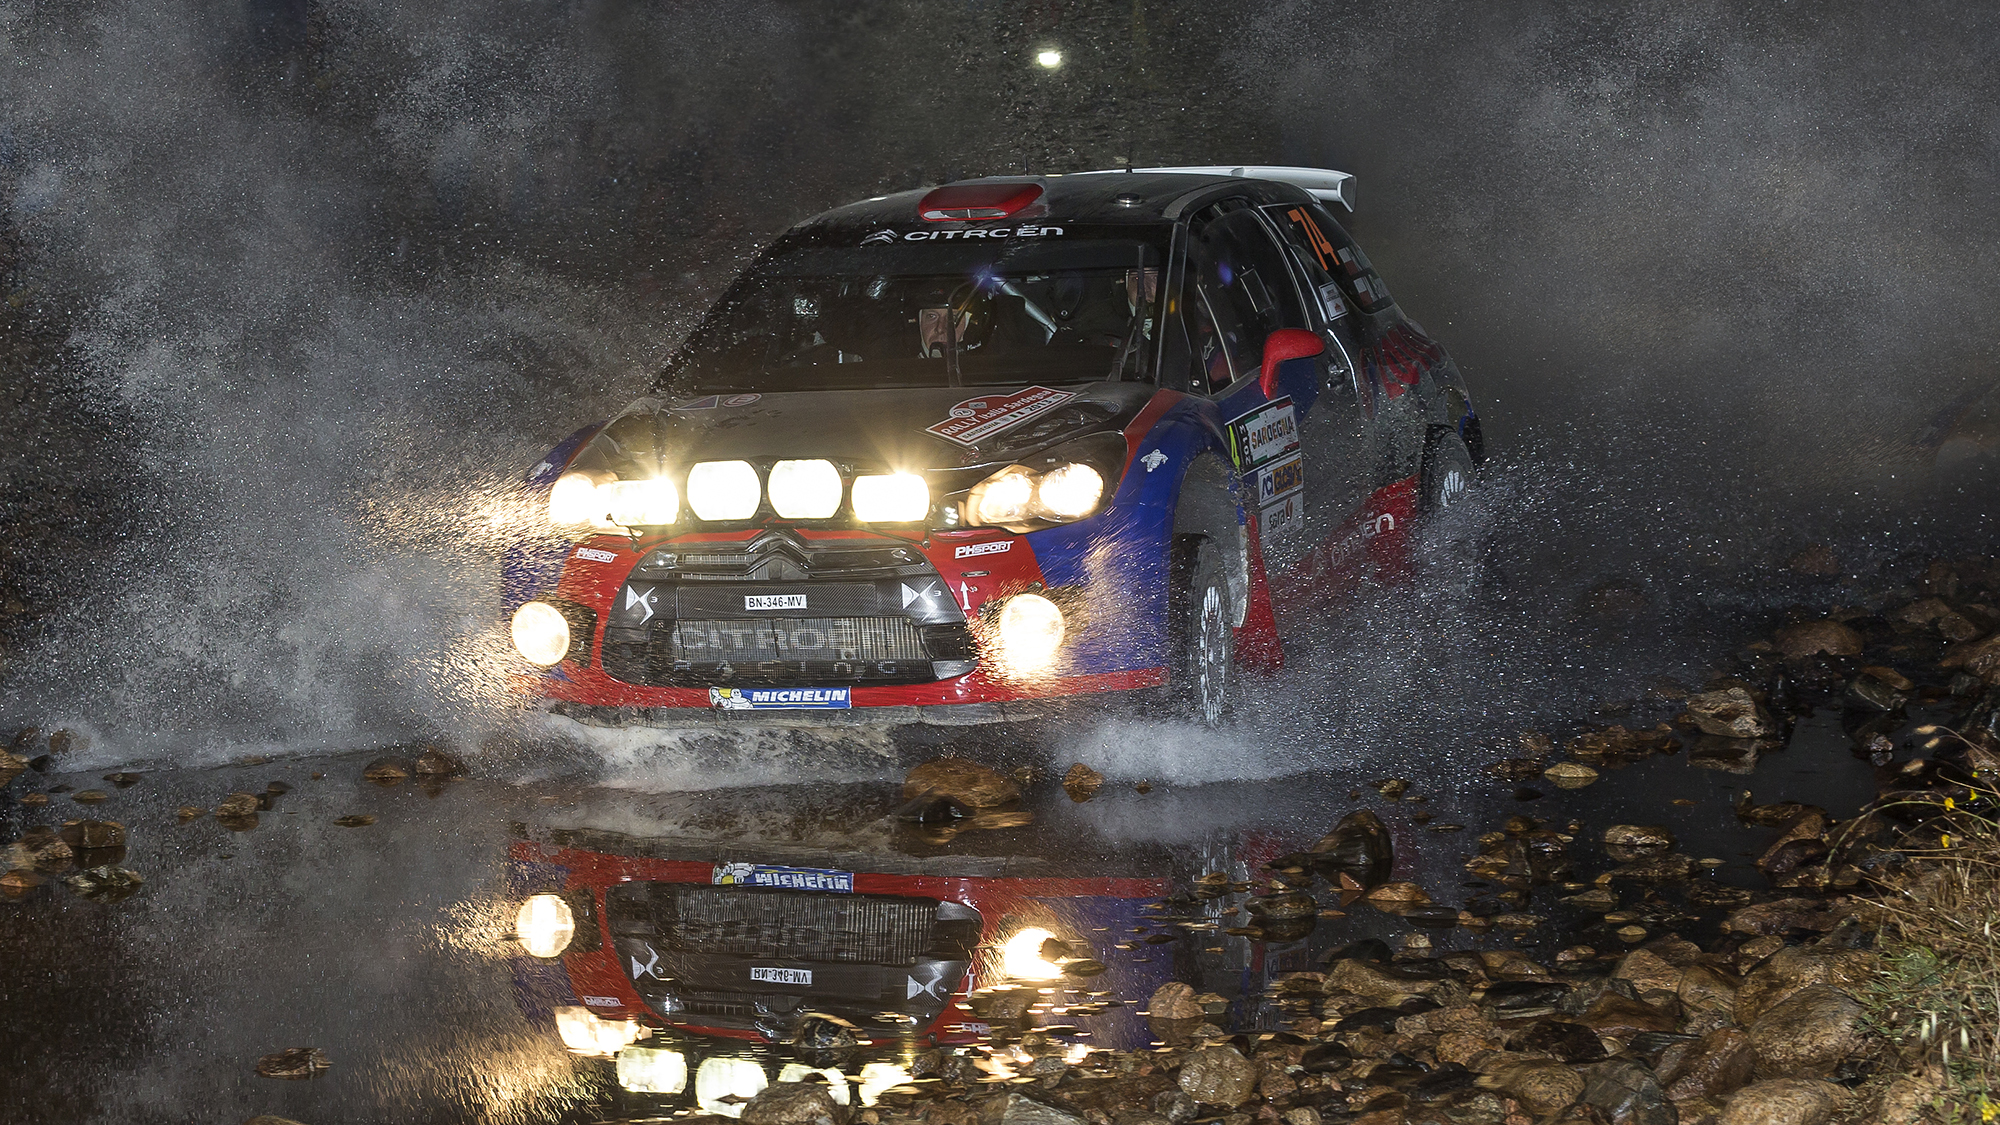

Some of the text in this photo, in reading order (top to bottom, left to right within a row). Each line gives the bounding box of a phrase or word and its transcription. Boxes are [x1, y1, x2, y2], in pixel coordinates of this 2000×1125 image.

[1287, 206, 1340, 271] 74
[941, 389, 1053, 435] RALLY Italia Sardegna
[1024, 399, 1053, 412] 2013
[1251, 416, 1296, 450] SARDEGNA
[1239, 424, 1252, 466] 2013
[576, 547, 618, 564] PHSPORT
[955, 541, 1014, 559] PHSPORT
[748, 595, 803, 609] BN-346-MV
[751, 690, 847, 702] MICHELIN
